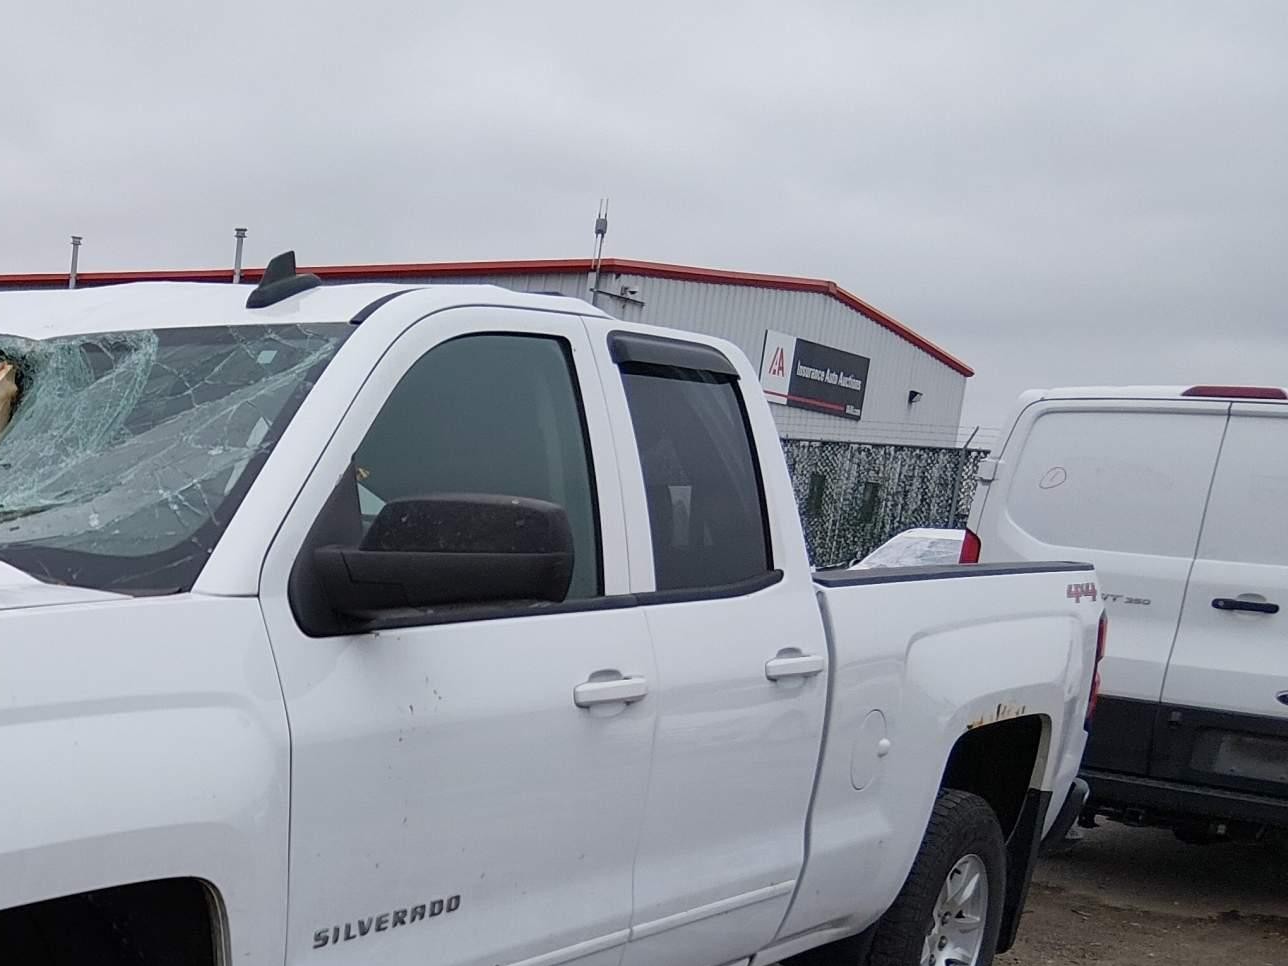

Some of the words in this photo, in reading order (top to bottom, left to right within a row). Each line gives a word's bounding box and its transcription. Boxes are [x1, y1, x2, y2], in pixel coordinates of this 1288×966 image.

[796, 360, 825, 382] Insurance
[824, 368, 839, 385] Auto
[838, 371, 862, 391] Auctions
[312, 894, 461, 949] SILVERADO
